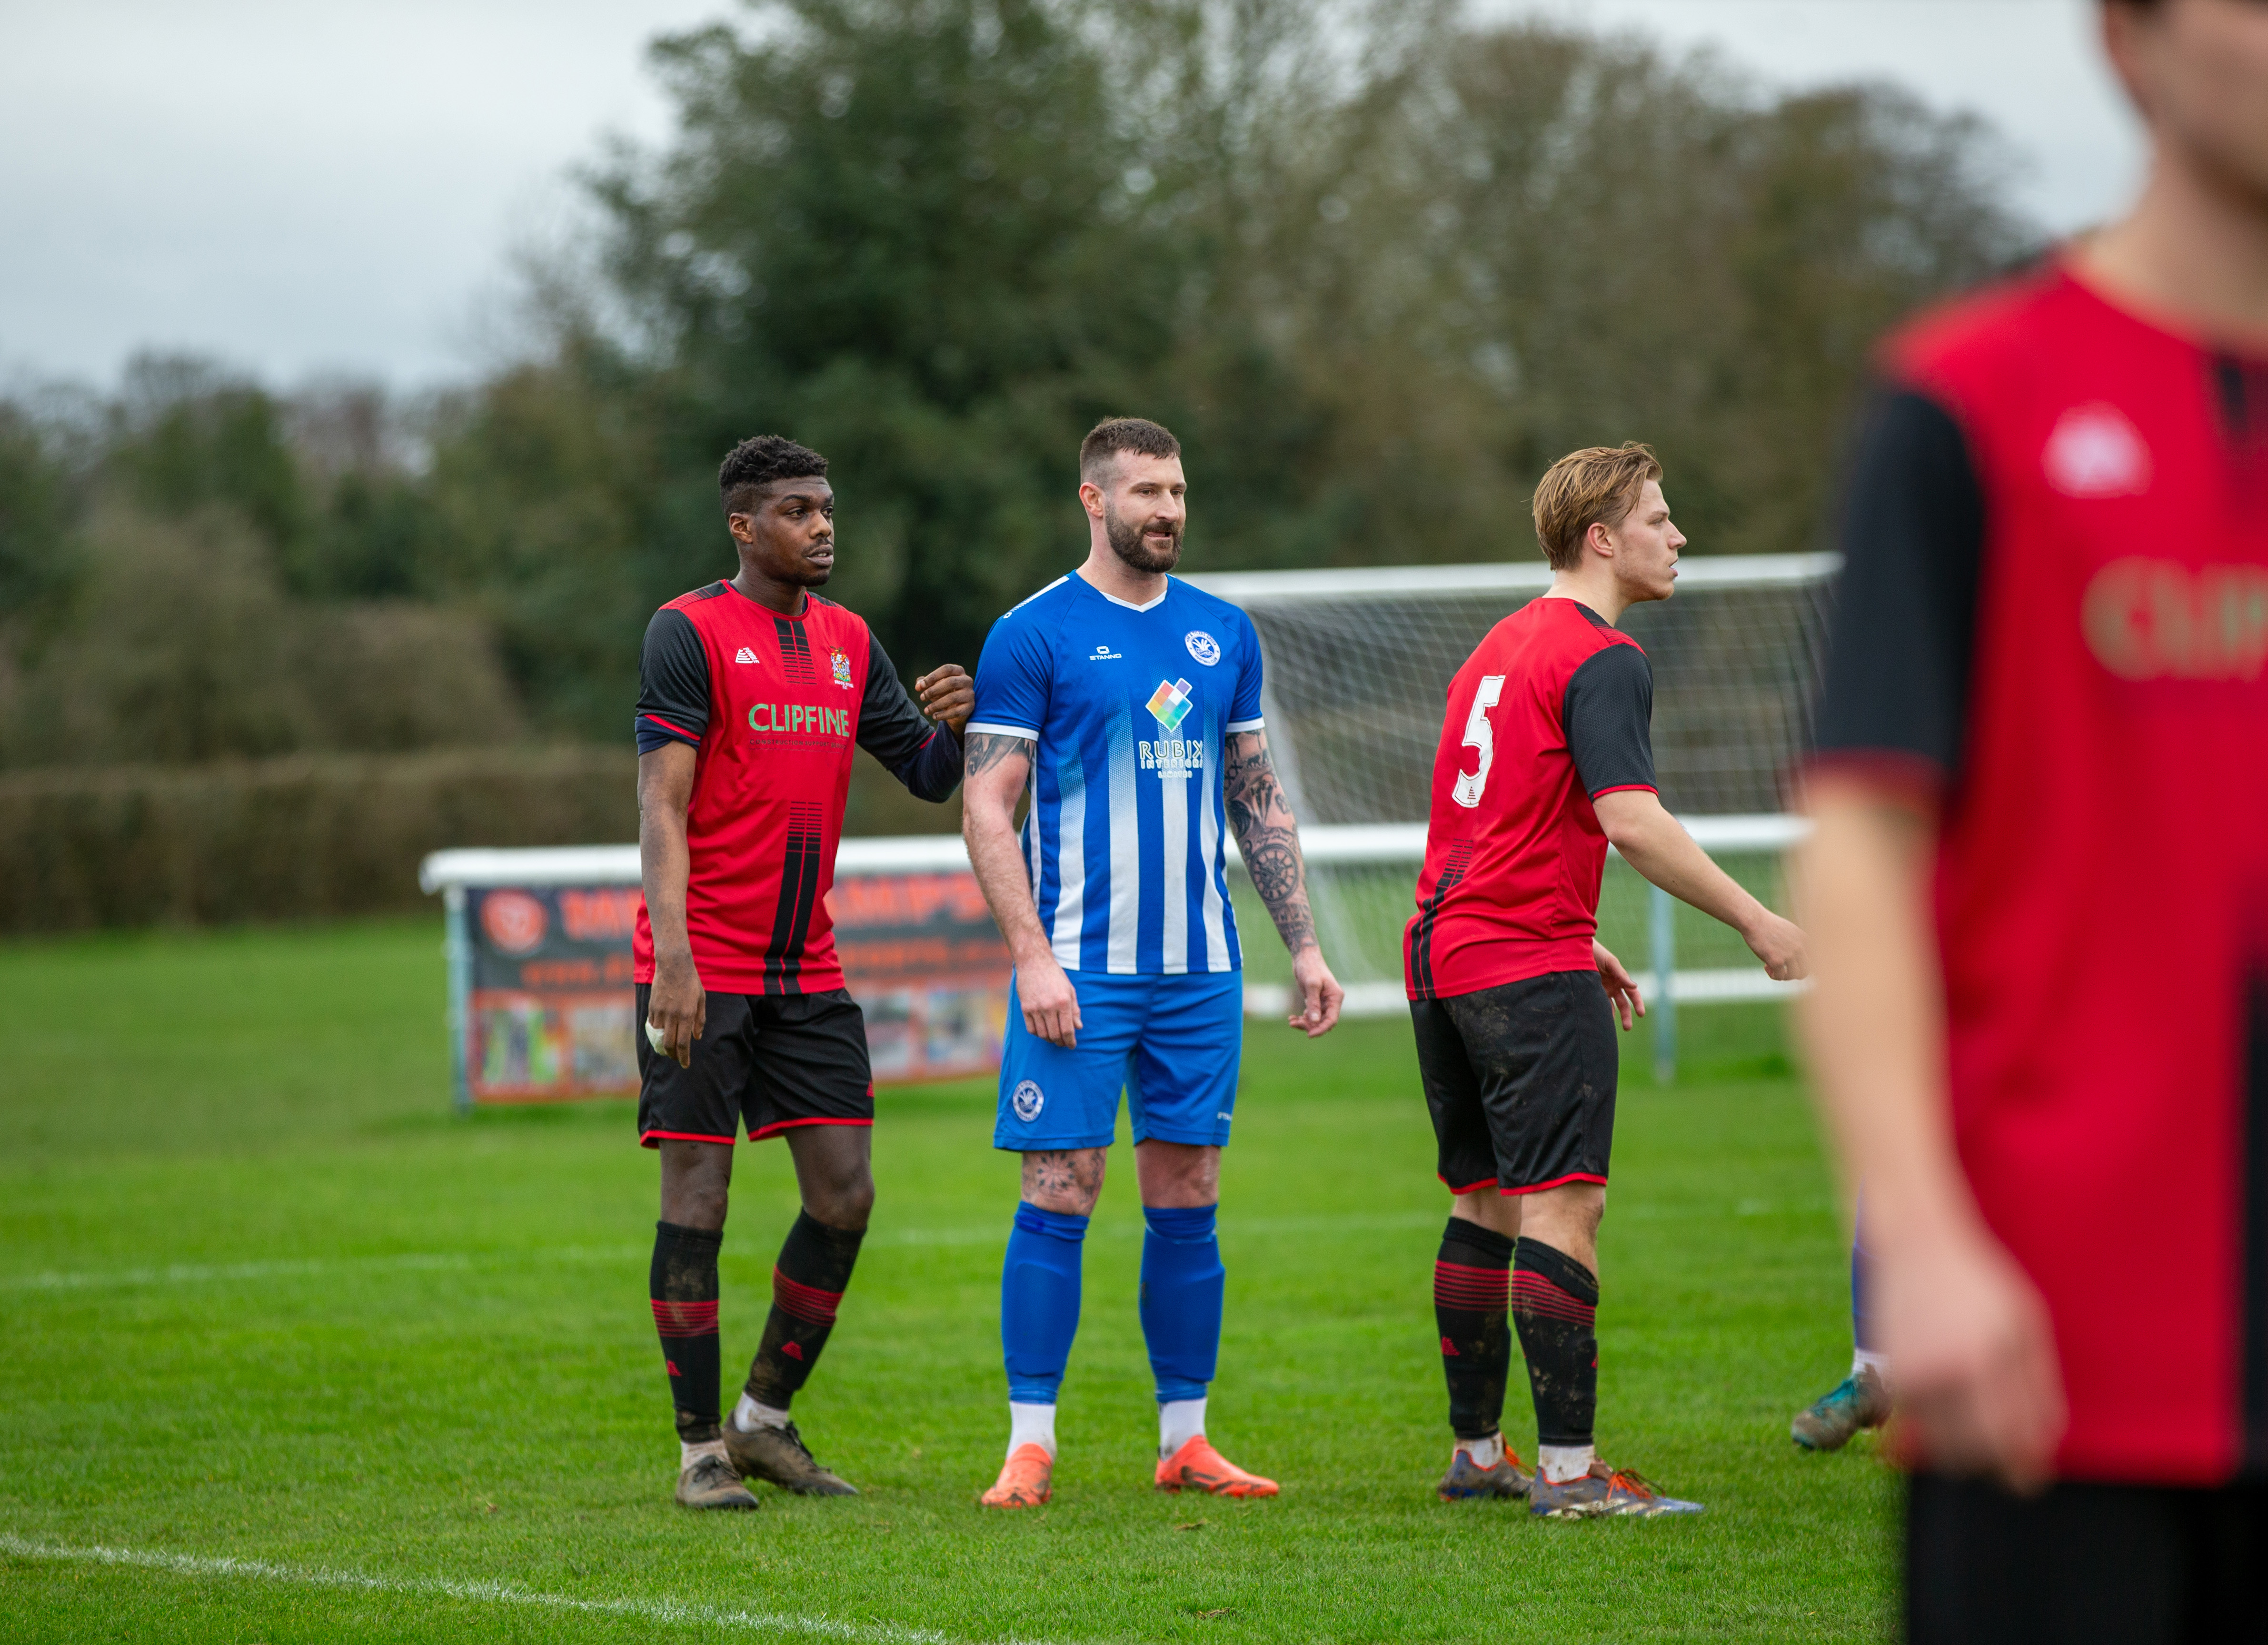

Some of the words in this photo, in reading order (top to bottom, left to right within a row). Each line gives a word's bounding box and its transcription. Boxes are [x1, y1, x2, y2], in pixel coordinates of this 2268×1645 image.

[748, 703, 849, 737] CLIPFINE
[1138, 740, 1203, 760] RUBIX
[1452, 675, 1506, 808] 5
